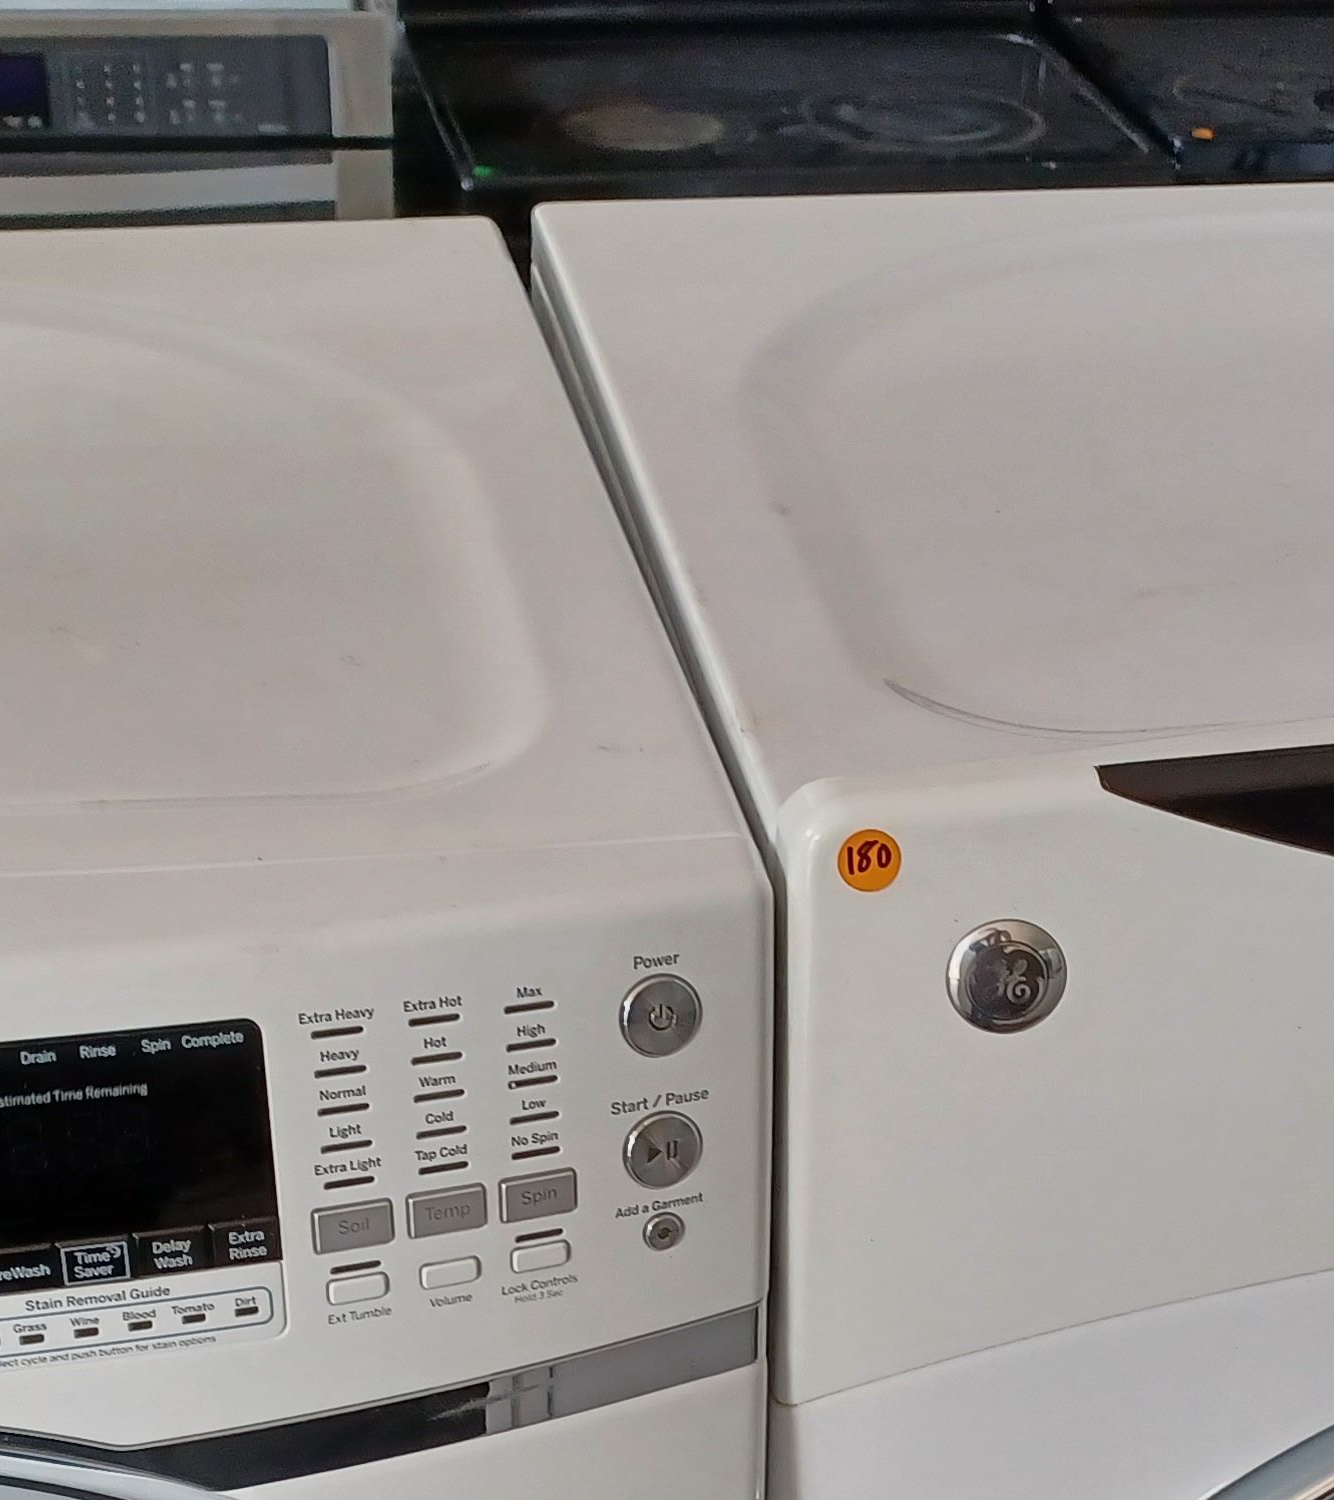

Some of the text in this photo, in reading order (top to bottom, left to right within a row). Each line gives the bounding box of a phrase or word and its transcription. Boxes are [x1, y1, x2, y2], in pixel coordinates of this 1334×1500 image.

[847, 840, 891, 875] 180
[633, 953, 680, 970] Power
[516, 986, 542, 998] Max
[403, 996, 462, 1013] Extra Hot
[299, 1008, 374, 1025] Extra Heavy
[517, 1024, 545, 1038] High
[20, 1049, 57, 1066] Drain
[80, 1043, 117, 1059] Rinse
[141, 1038, 171, 1055] Spin
[181, 1030, 245, 1049] Complete
[423, 1037, 447, 1049] Hot
[320, 1050, 359, 1062] Heavy
[507, 1060, 557, 1076] Medium
[419, 1074, 455, 1088] Warm
[52, 1088, 83, 1103] Time
[85, 1081, 149, 1100] Remaining
[319, 1086, 366, 1100] Normal
[521, 1099, 546, 1110] Low
[611, 1098, 649, 1116] Start
[665, 1089, 709, 1106] Pause
[425, 1112, 453, 1124] Cold
[329, 1124, 361, 1139] Light
[511, 1131, 559, 1147] No Spin
[415, 1144, 467, 1162] Tap Cold
[314, 1157, 381, 1176] Extra Light
[521, 1188, 558, 1206] Spin
[615, 1205, 639, 1218] Add
[652, 1192, 703, 1213] Garment
[425, 1204, 471, 1222] Temp
[338, 1217, 370, 1235] Soil
[228, 1230, 265, 1245] Extra
[152, 1239, 191, 1256] Delay
[229, 1245, 268, 1261] Rinse
[74, 1251, 110, 1264] Time
[153, 1253, 193, 1270] Wash
[74, 1264, 115, 1279] Saver
[501, 1274, 578, 1295] Lock Controls
[25, 1285, 170, 1312] Stain Removal Guide
[430, 1293, 473, 1308] Volume
[13, 1323, 47, 1334] Grass
[70, 1317, 100, 1327] Wine
[122, 1310, 157, 1322] Blood
[172, 1303, 215, 1315] Tomato
[327, 1306, 392, 1325] Ext Tumble
[21, 1357, 48, 1367] cycle
[49, 1354, 70, 1363] and
[71, 1350, 97, 1362] push
[99, 1346, 133, 1357] button
[135, 1343, 150, 1352] for
[152, 1341, 177, 1350] stain
[178, 1335, 217, 1349] options
